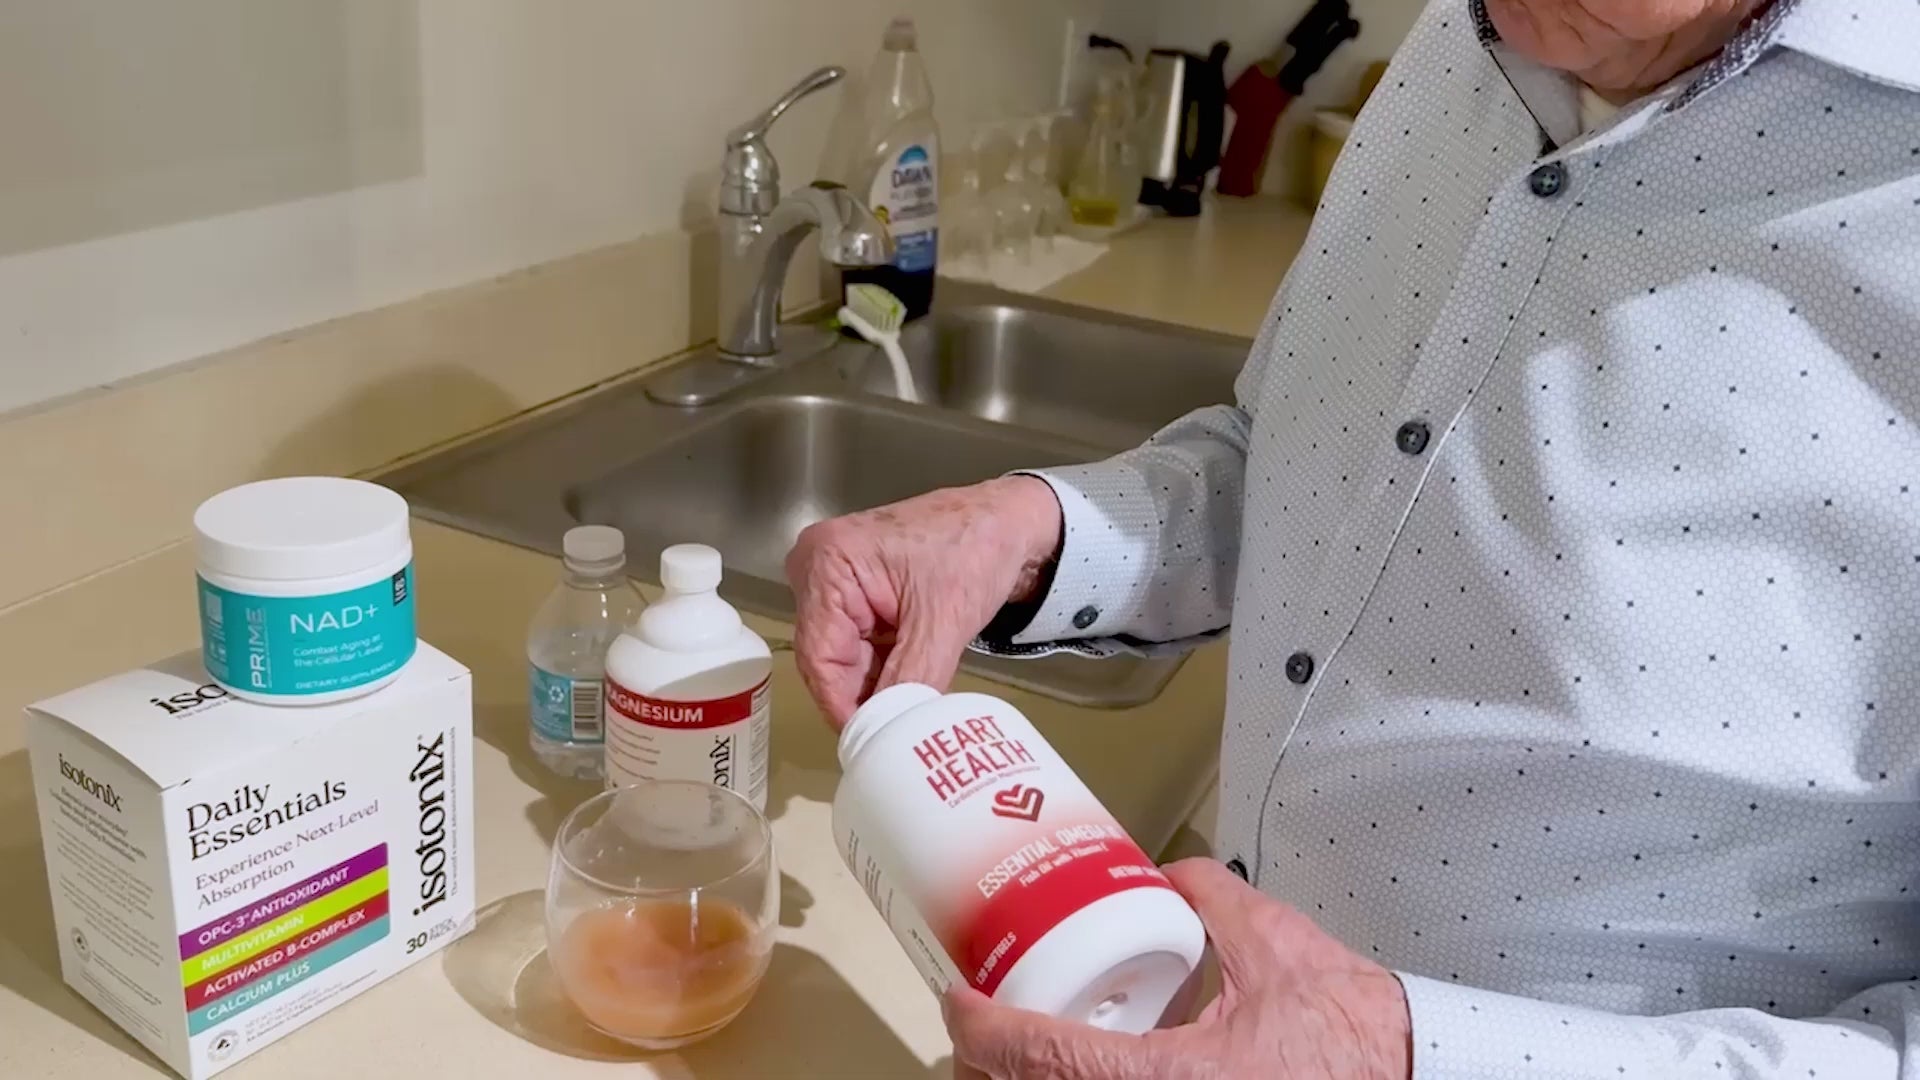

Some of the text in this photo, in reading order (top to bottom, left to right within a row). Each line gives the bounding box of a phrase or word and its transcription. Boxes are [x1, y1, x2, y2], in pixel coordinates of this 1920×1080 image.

[290, 604, 379, 634] NAD+
[293, 634, 381, 656] Combat Aging at
[246, 608, 267, 688] PRIME
[294, 644, 383, 667] the Cellular Level
[296, 660, 396, 690] DIETARY SUPPLEMENT
[913, 715, 1005, 770] HEART
[926, 739, 1036, 801] HEALTH
[58, 753, 121, 813] isotonix
[186, 784, 270, 833] Daily
[189, 781, 347, 860] Essentials
[195, 840, 292, 890] Experience
[296, 800, 379, 847] Next-Level
[409, 732, 447, 916] isotonix
[197, 860, 295, 911] Absorption
[977, 836, 1060, 899] ESSENTIAL
[1055, 823, 1106, 847] OMEGA
[1018, 869, 1041, 888] Fish
[250, 867, 350, 922] ANTIOXIDANT
[202, 914, 304, 971] MULTIVITAMIN
[204, 949, 284, 997] ACTIVATED
[286, 908, 366, 957] B-COMPLEX
[406, 931, 428, 954] 30
[983, 931, 1017, 973] SOFTGELS
[206, 980, 273, 1021] CALCIUM
[276, 961, 311, 986] PLUS
